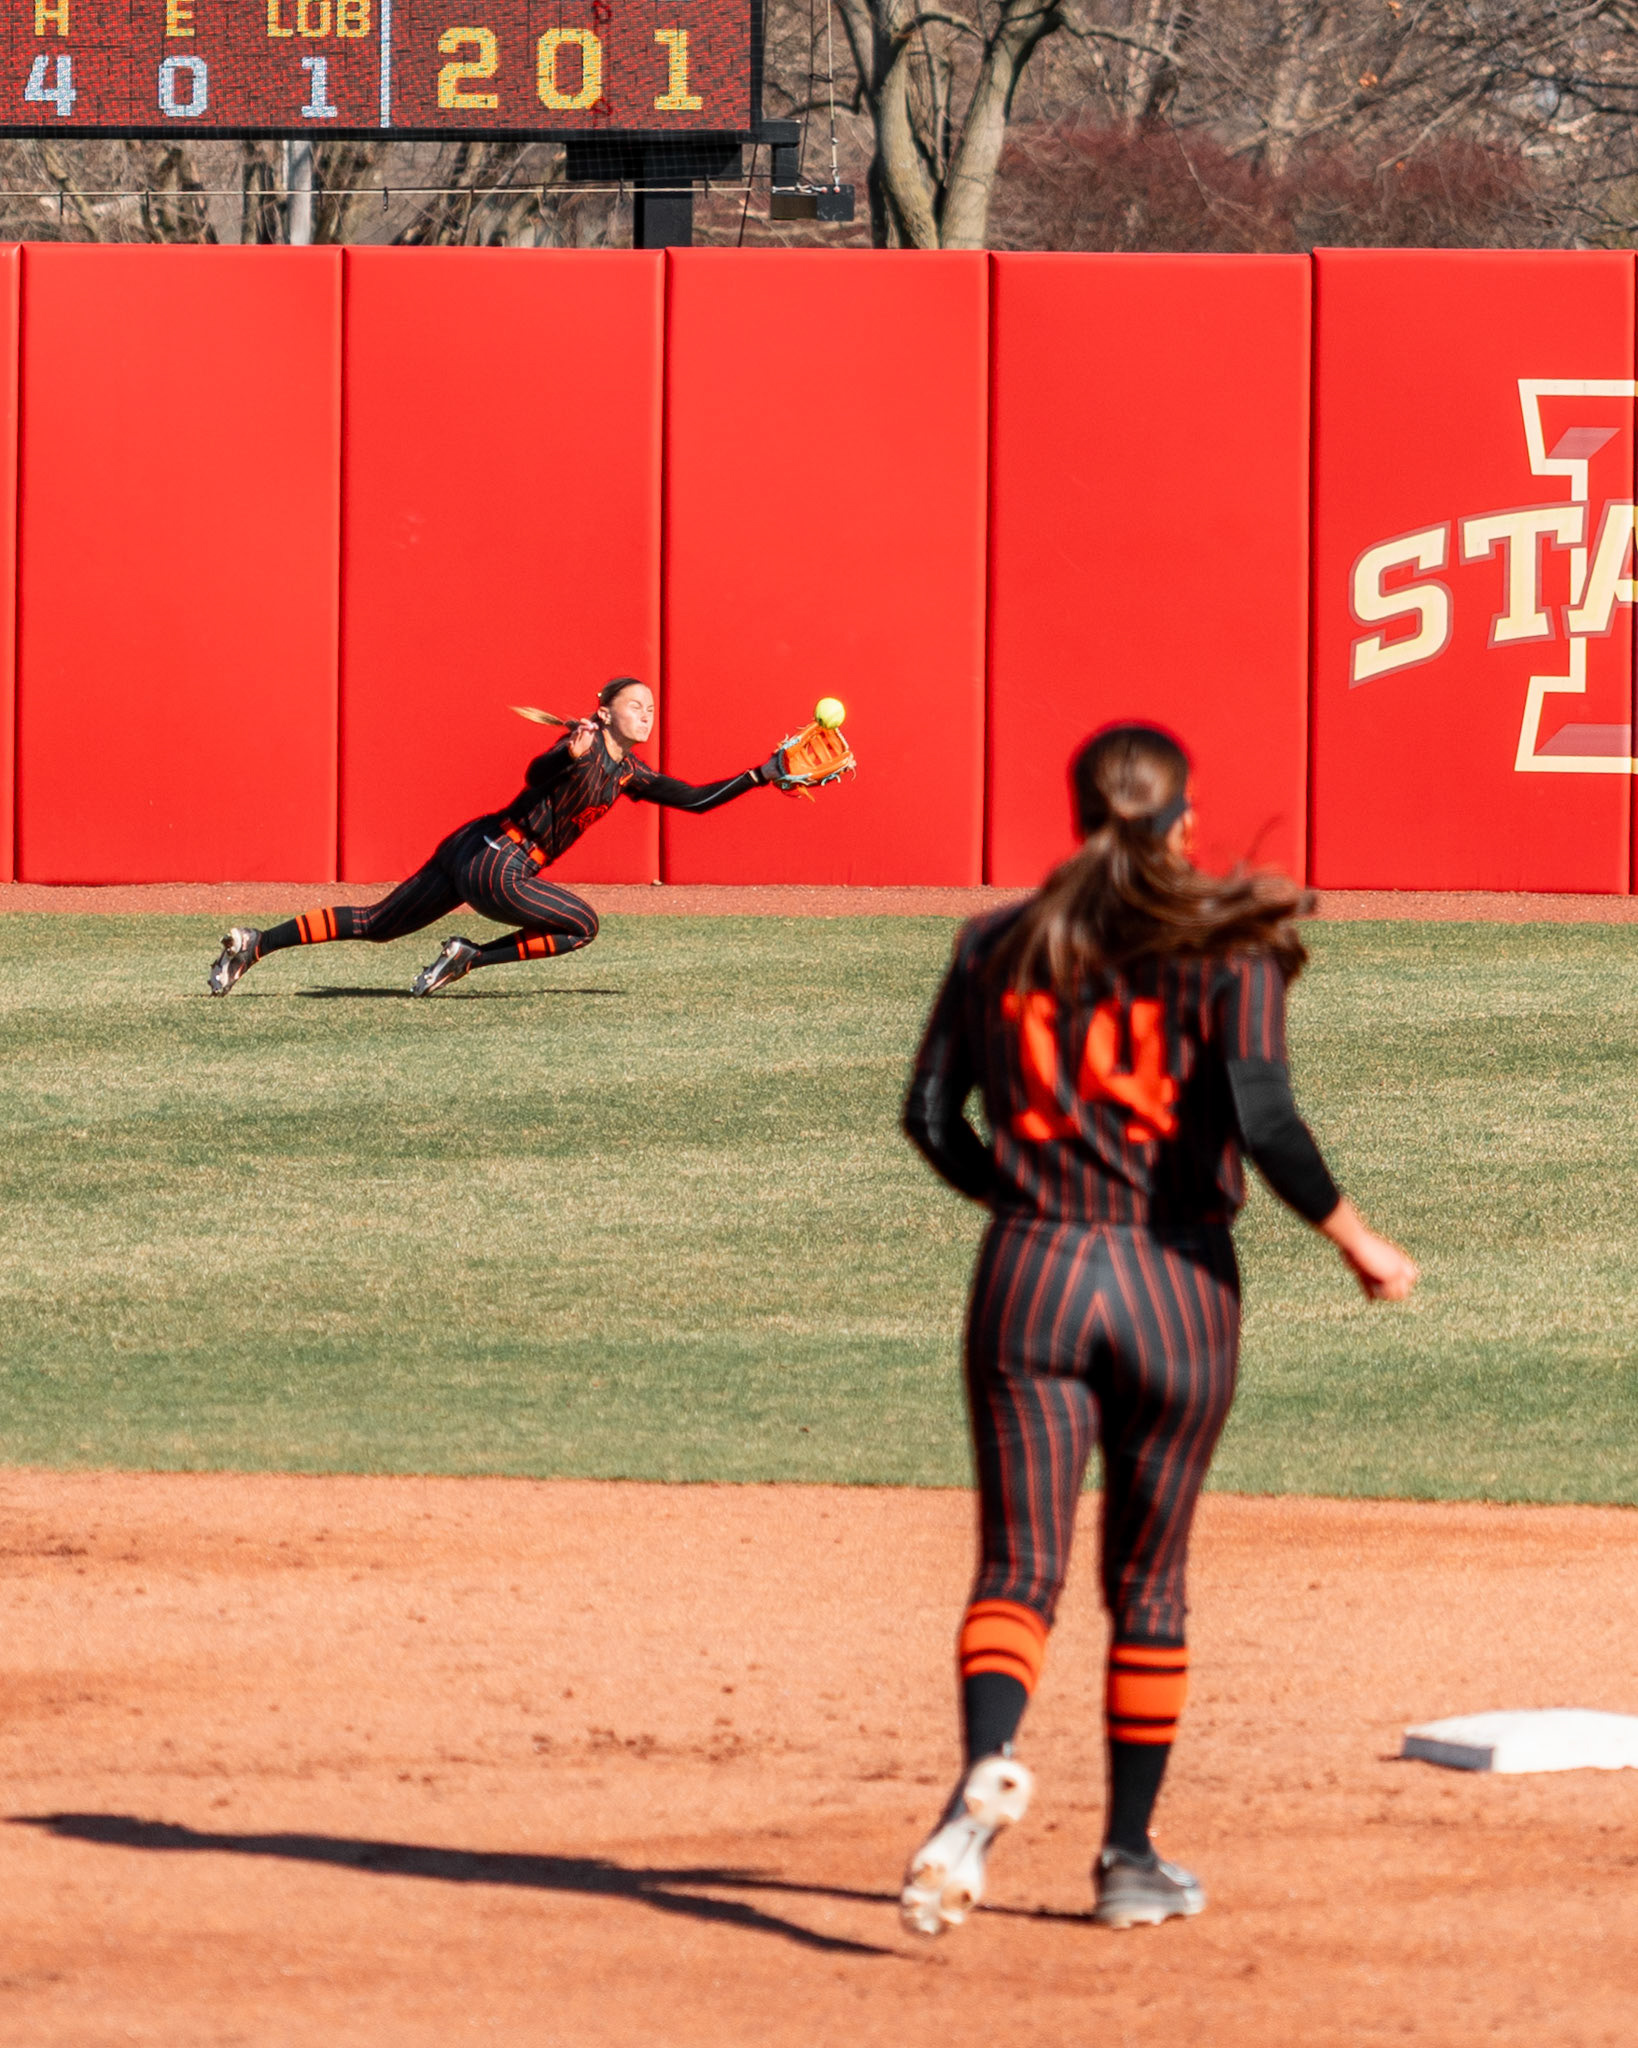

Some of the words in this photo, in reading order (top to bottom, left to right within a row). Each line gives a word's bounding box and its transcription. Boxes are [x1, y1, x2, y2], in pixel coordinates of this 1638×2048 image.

[34, 0, 69, 36] H
[166, 0, 195, 37] E
[266, 0, 371, 38] LOB
[24, 55, 76, 117] 4
[158, 55, 208, 117] 0
[301, 56, 338, 118] 1
[437, 27, 498, 109] 2
[537, 28, 602, 110] 0
[654, 29, 703, 110] 1
[1002, 988, 1179, 1143] 14
